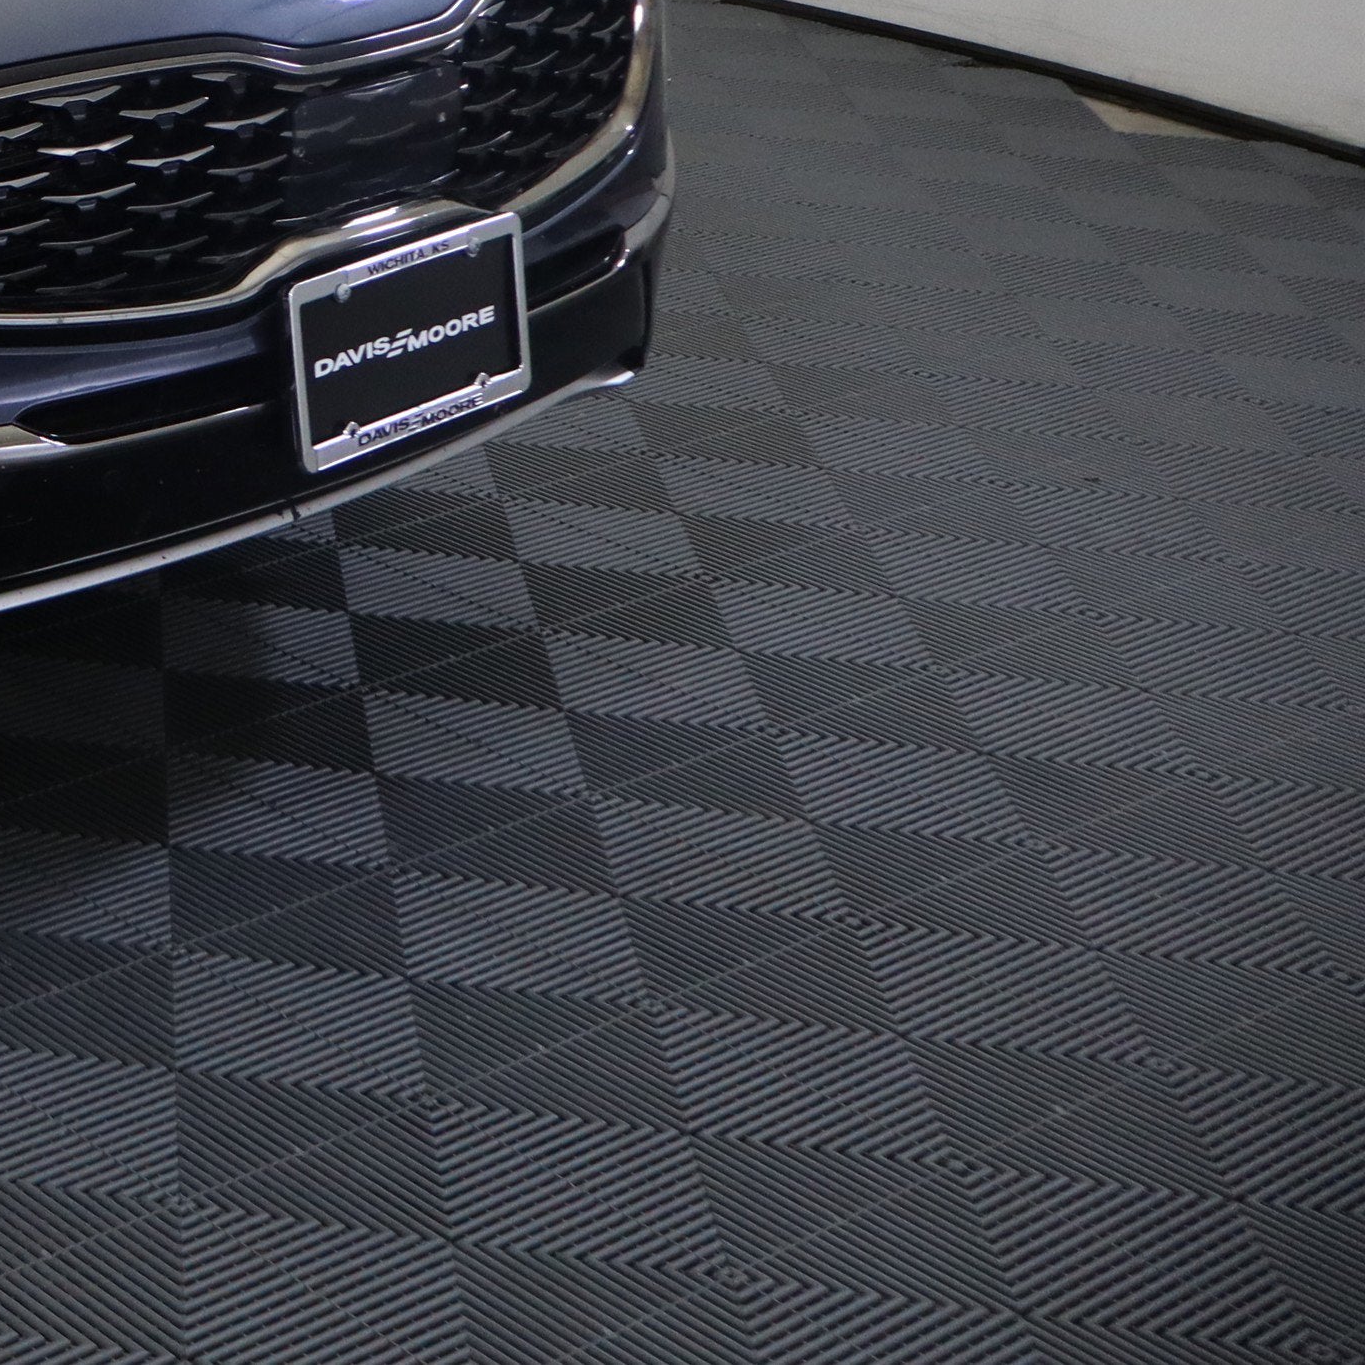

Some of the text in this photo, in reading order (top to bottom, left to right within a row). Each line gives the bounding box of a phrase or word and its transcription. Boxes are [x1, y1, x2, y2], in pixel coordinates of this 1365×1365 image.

[431, 240, 450, 255] KS
[314, 305, 495, 378] DAVIS MOORE
[358, 393, 484, 447] DAVIS MOORE
